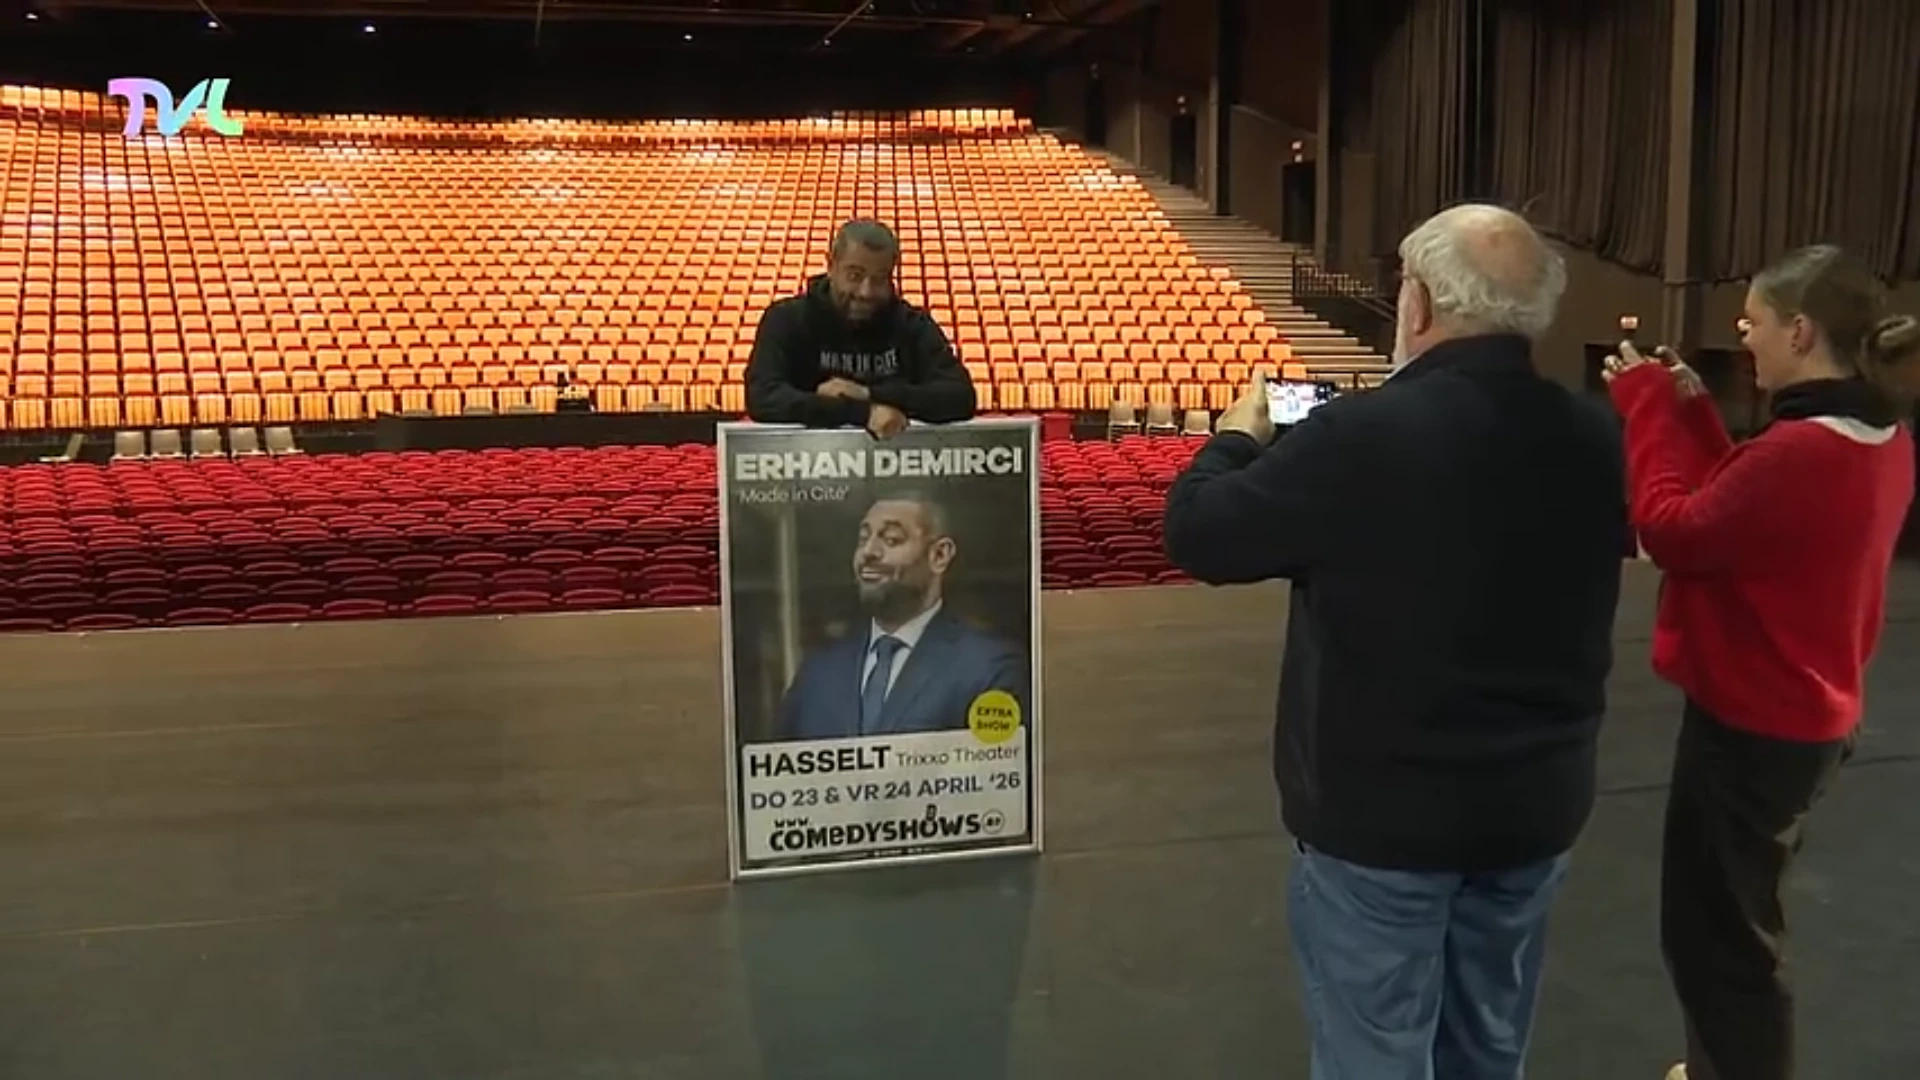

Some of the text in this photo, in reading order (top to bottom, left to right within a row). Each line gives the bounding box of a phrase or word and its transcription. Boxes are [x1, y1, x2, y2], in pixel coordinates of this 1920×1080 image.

[735, 447, 1022, 481] ERHAN DEMIRCI
[792, 485, 808, 501] in
[976, 706, 1013, 718] EXTRA
[976, 719, 1011, 731] SHOW
[750, 745, 1020, 777] HASSELT Trixxo Theater
[751, 791, 785, 810] DO
[792, 788, 818, 806] 23
[824, 786, 839, 804] &
[846, 781, 880, 802] VR
[885, 780, 911, 798] 24
[917, 775, 983, 797] APRIL
